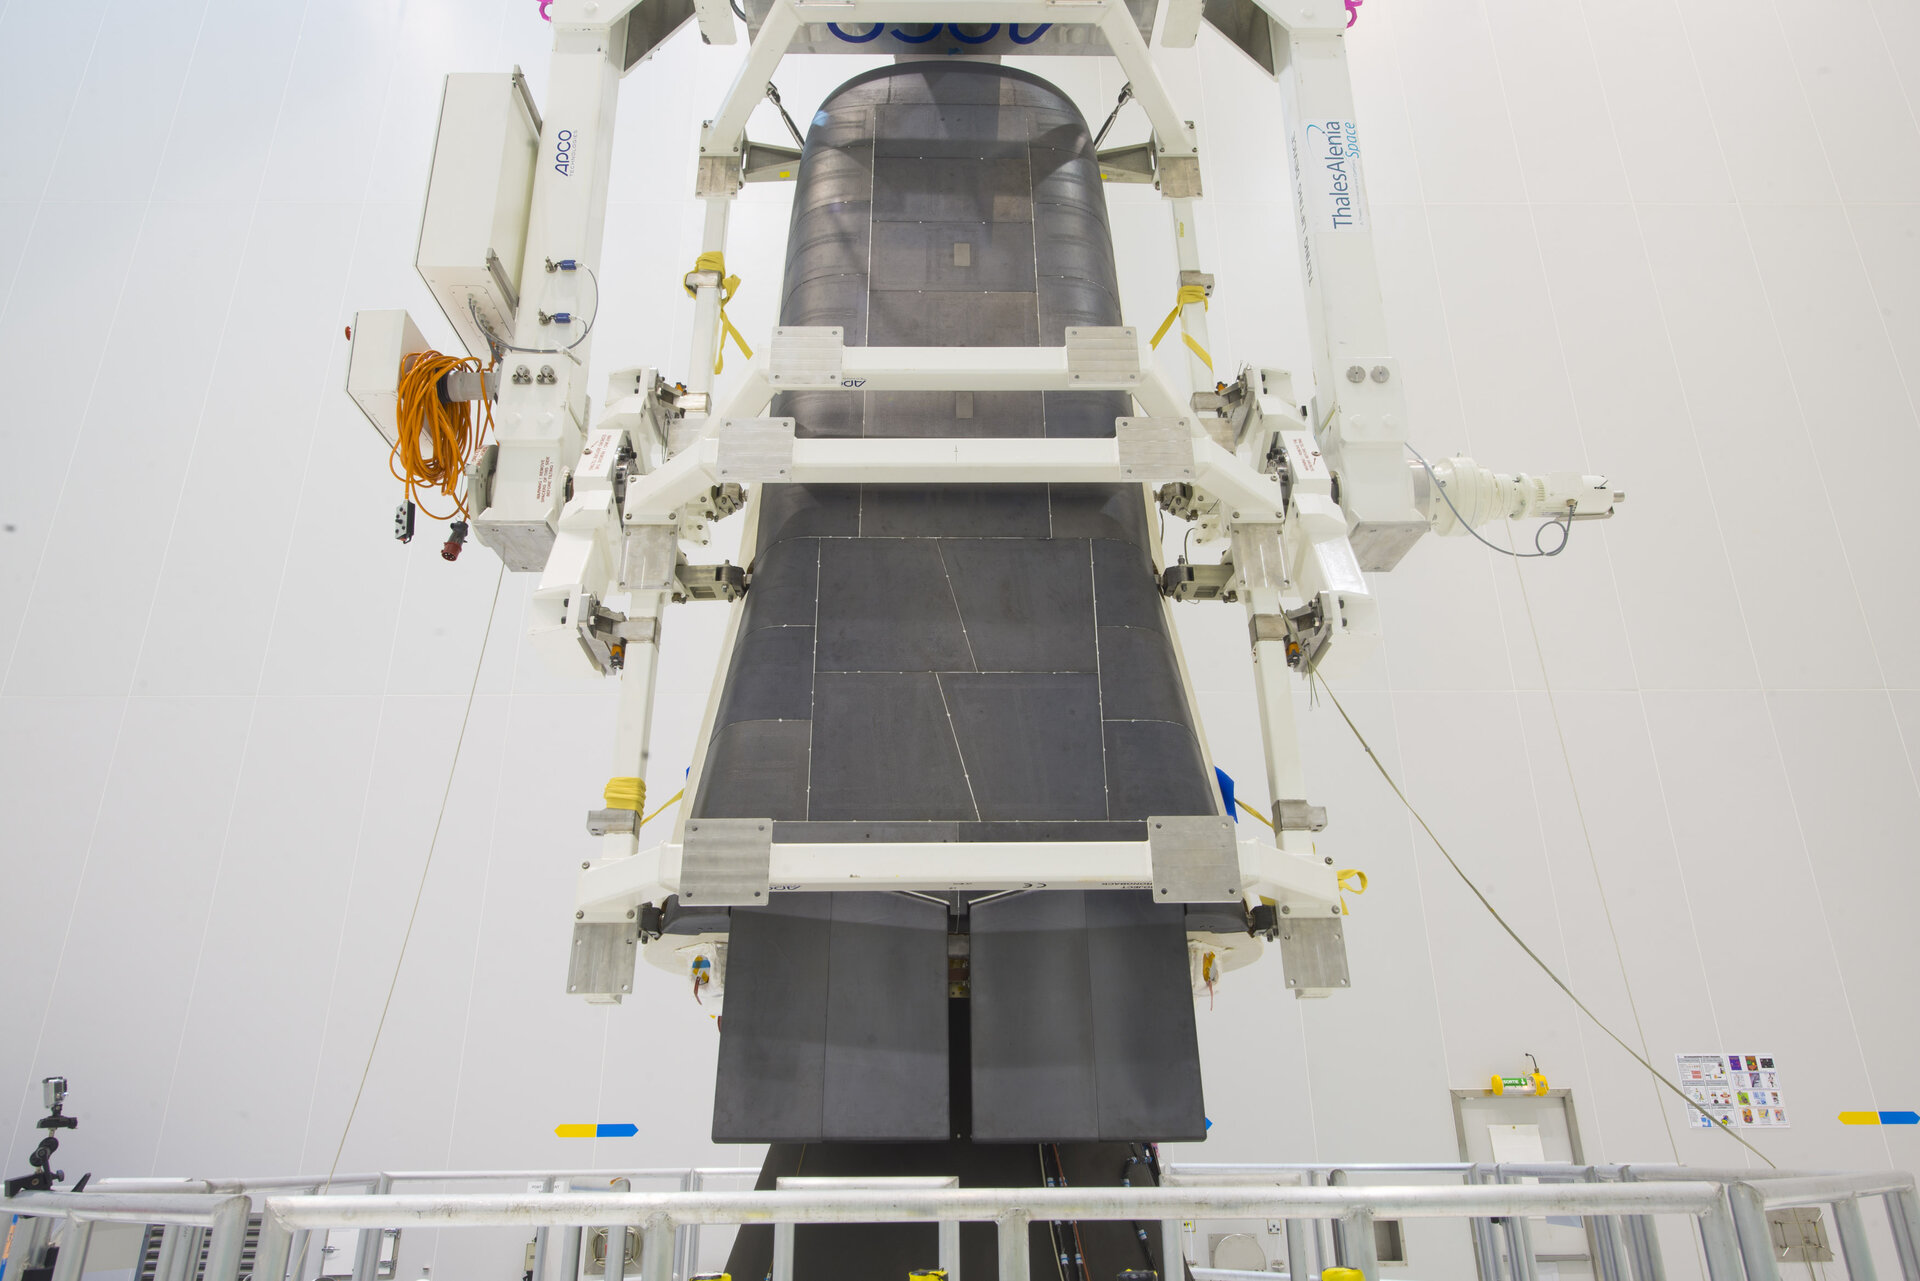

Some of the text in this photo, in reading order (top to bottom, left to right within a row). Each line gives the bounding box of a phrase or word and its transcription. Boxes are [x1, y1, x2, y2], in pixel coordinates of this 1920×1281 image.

[555, 130, 572, 176] APCO
[1345, 122, 1360, 158] Space
[1291, 131, 1313, 287] TILTING LIFTING DEVICE
